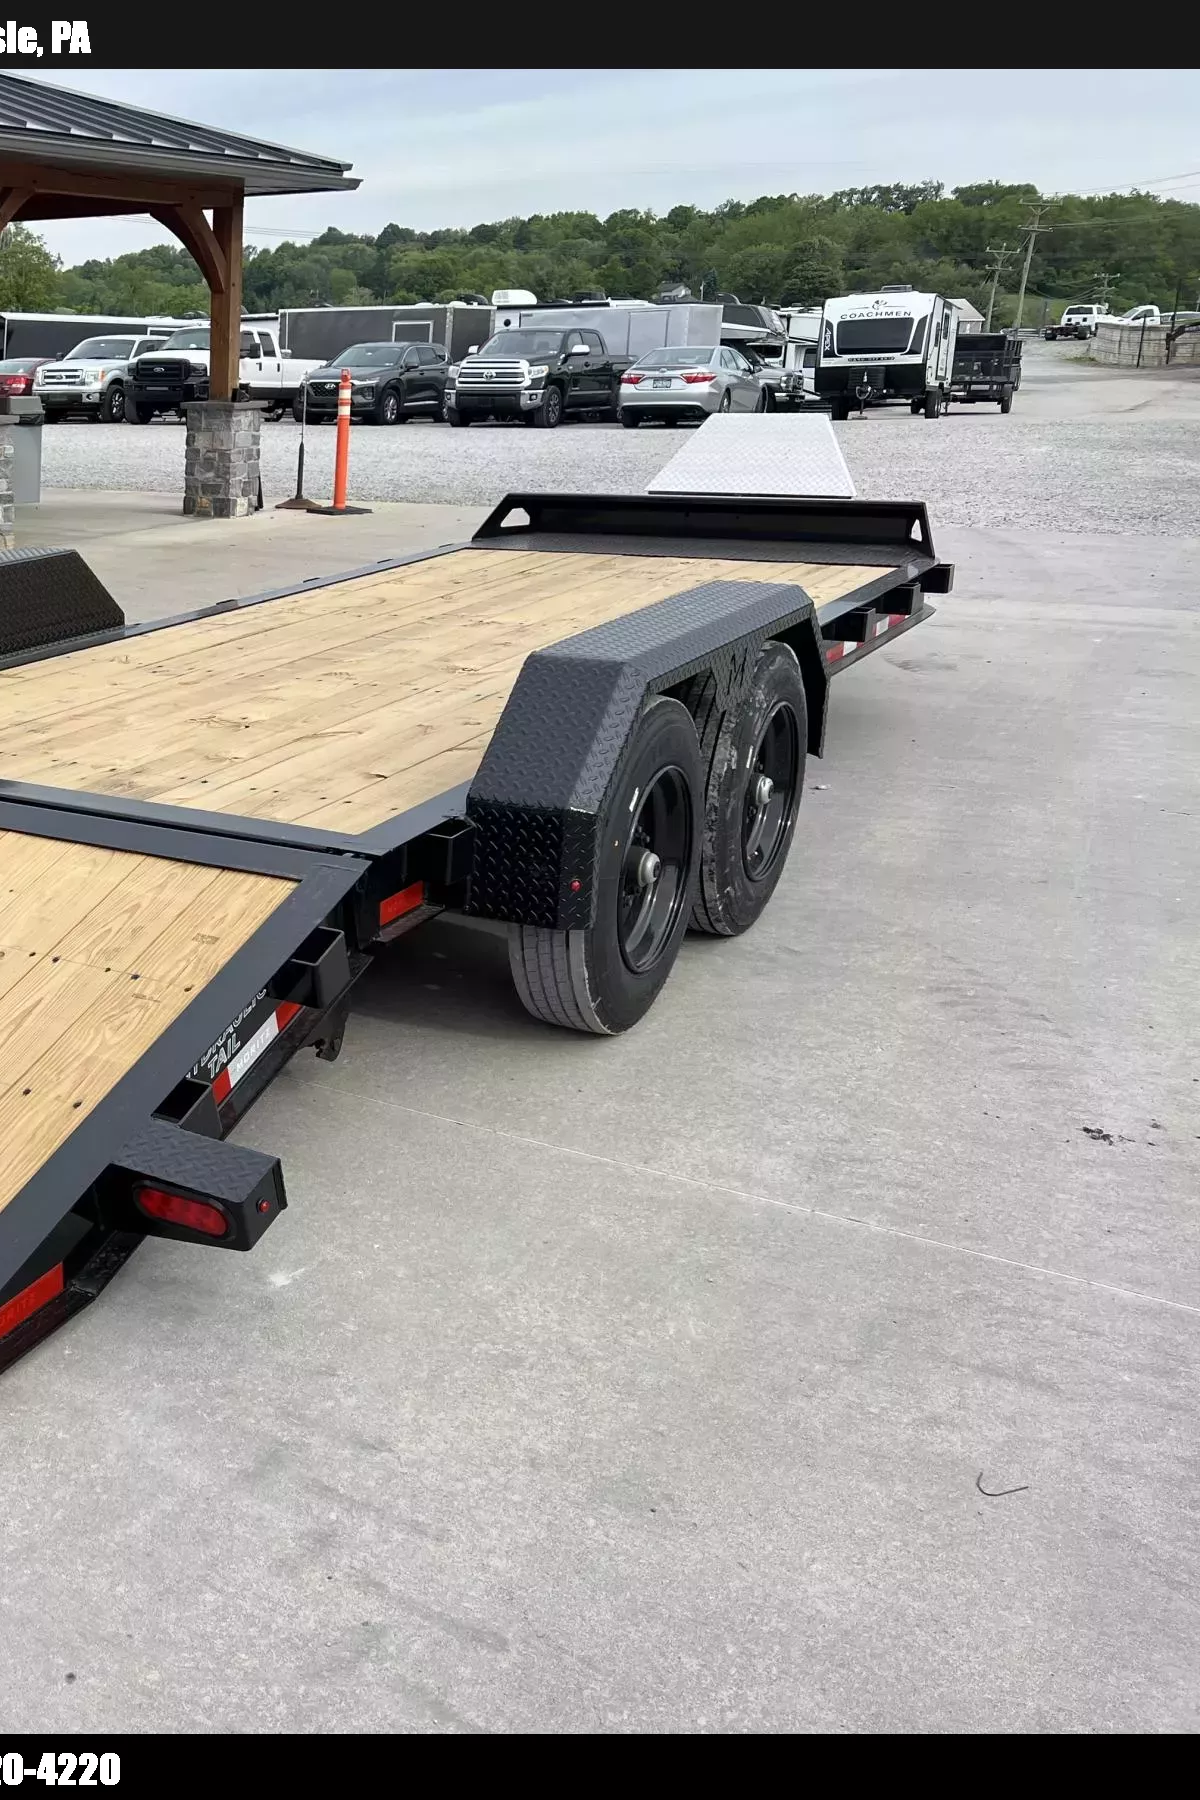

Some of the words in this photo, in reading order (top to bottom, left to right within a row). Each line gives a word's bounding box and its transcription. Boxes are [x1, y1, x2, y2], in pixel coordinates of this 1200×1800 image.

[840, 311, 912, 319] COACHMEN
[824, 327, 832, 351] APEX
[207, 1032, 241, 1079] TAIL
[235, 1026, 272, 1073] MORITZ
